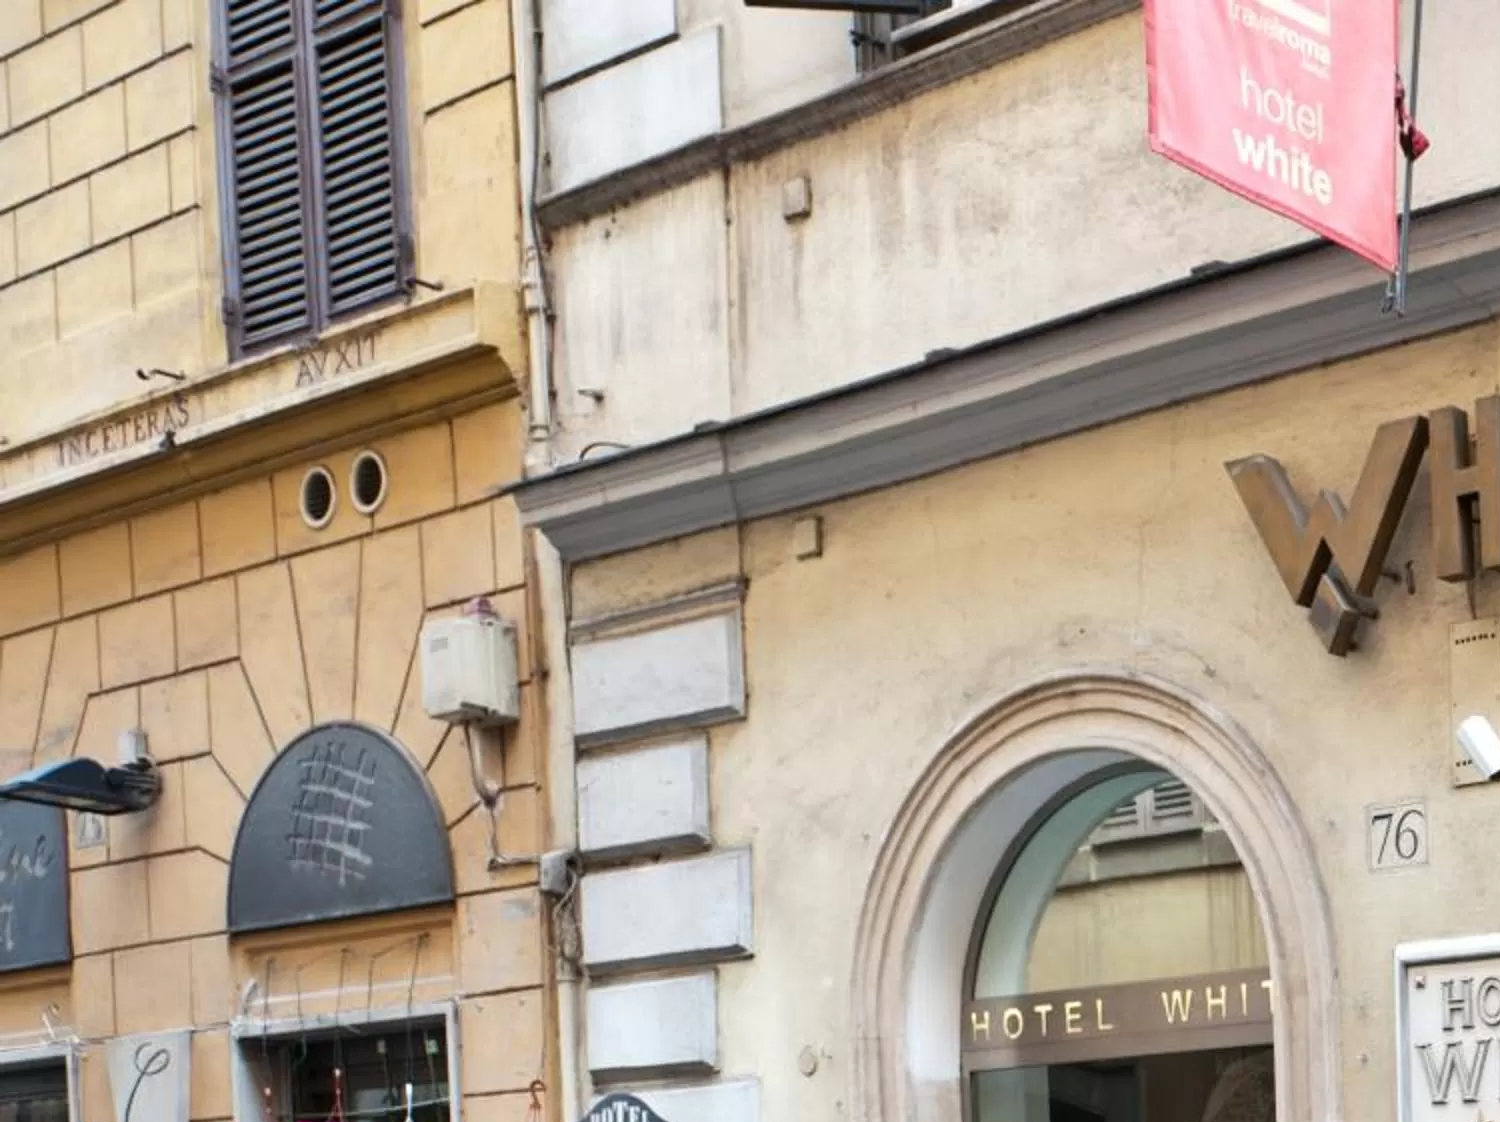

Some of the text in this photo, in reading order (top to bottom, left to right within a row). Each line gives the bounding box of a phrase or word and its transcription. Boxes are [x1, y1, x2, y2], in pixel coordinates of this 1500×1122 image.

[1240, 64, 1324, 144] hotel
[1231, 127, 1332, 206] white
[1371, 809, 1424, 864] 76
[969, 999, 1115, 1041] HOTEL
